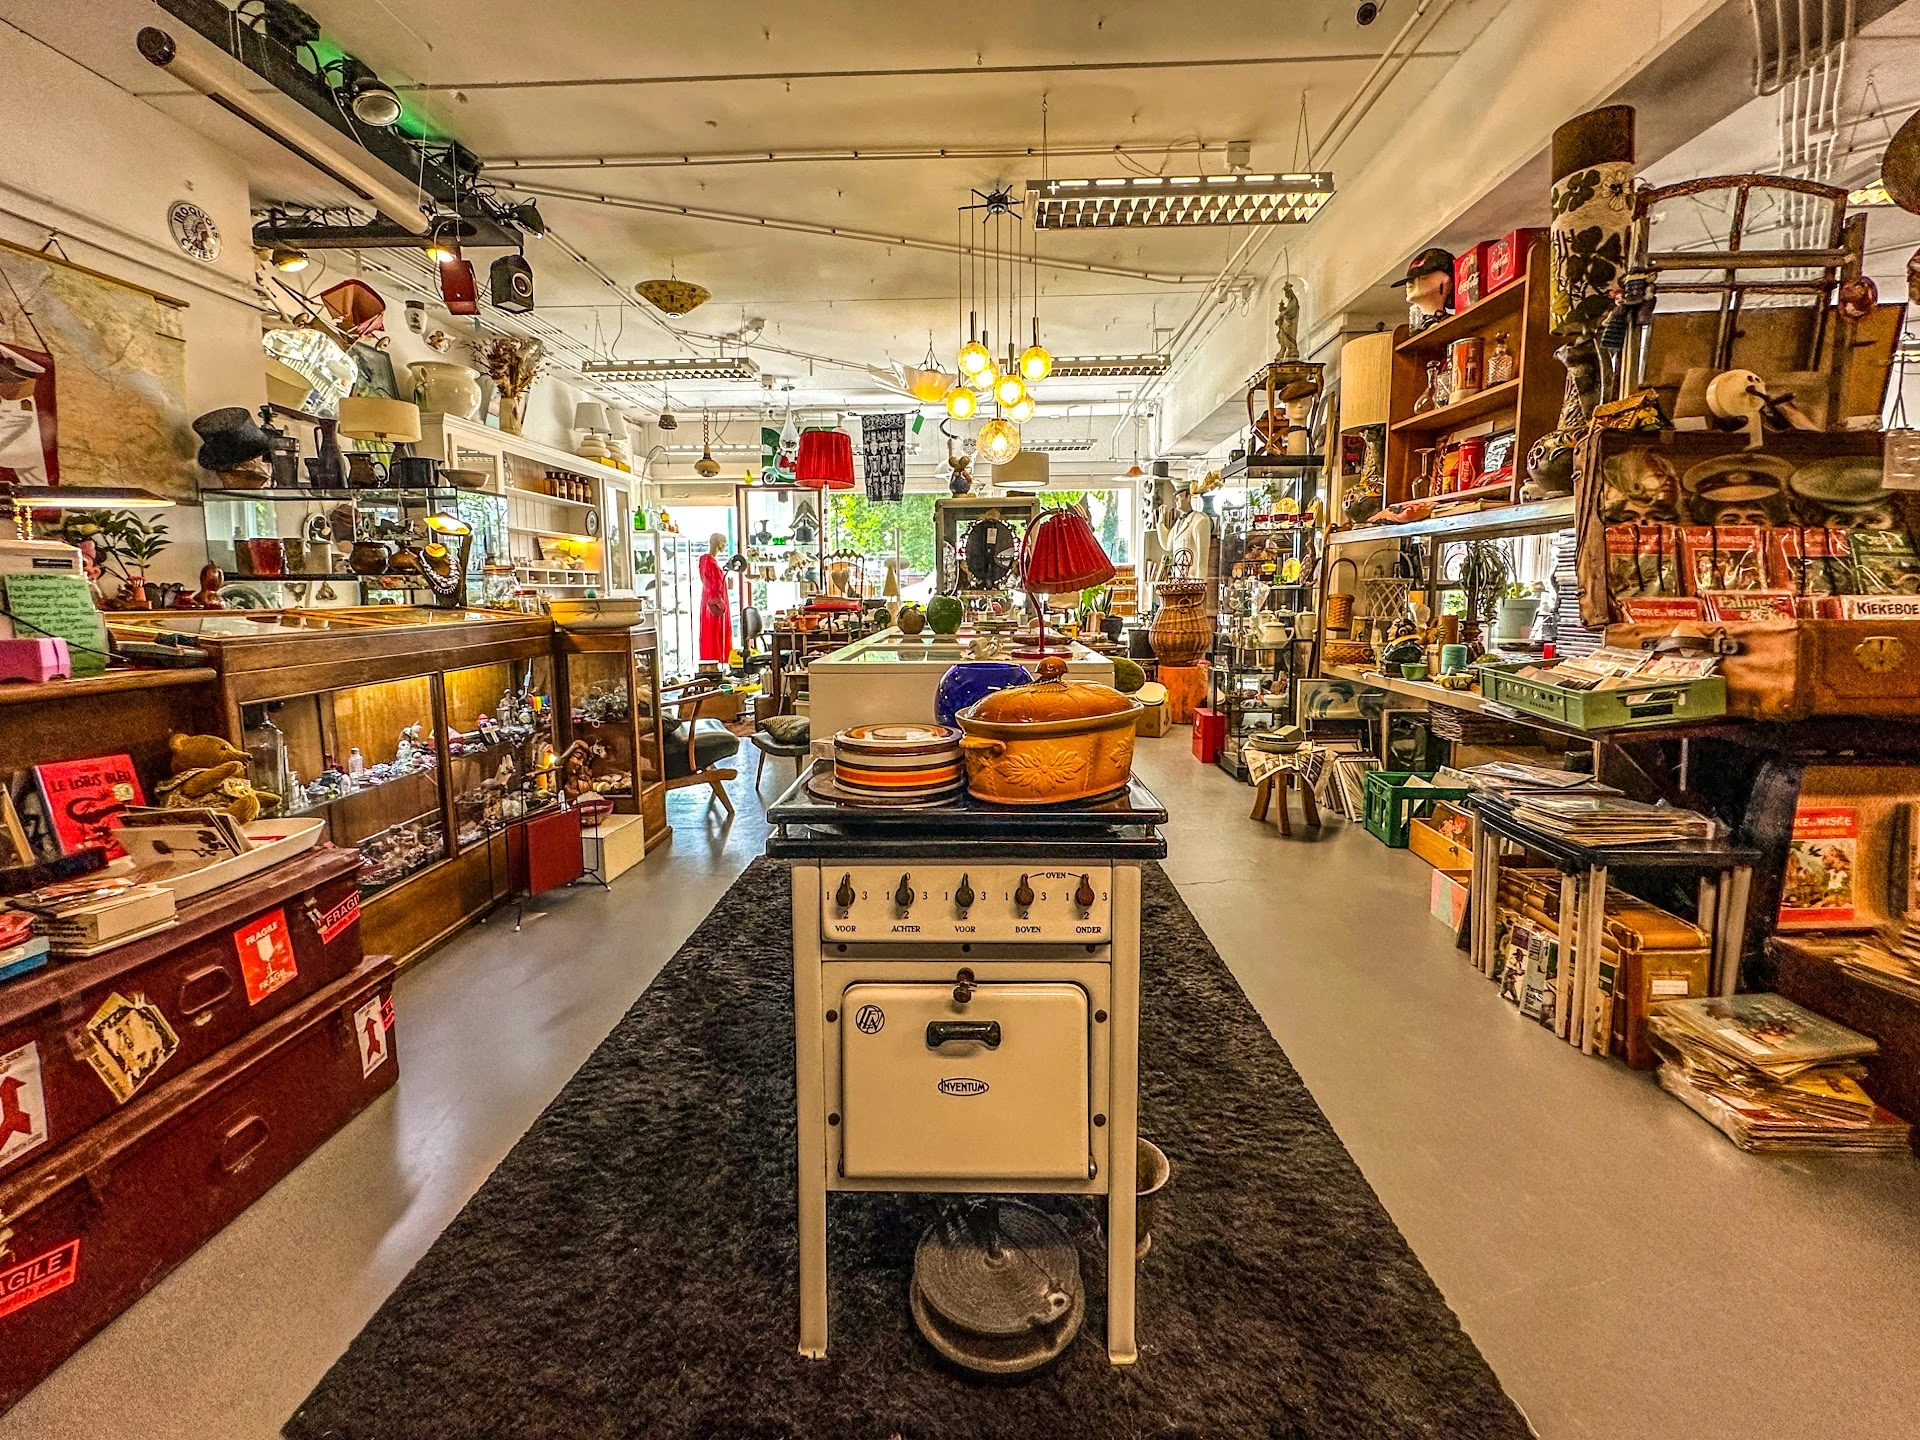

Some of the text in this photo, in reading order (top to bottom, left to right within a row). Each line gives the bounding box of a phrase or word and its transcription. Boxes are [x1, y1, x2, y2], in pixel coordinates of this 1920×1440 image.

[174, 207, 219, 238] IROQUOIS
[1668, 608, 1698, 617] WISKE
[52, 779, 66, 793] LE
[69, 772, 101, 790] LOTUS
[104, 769, 132, 784] BLEU
[1817, 815, 1852, 827] WISKE
[826, 891, 868, 900] 1 3
[886, 891, 928, 900] 1 3
[945, 892, 987, 900] 1 3
[1005, 892, 1047, 900] 1 3
[1066, 892, 1108, 901] 1 3
[843, 911, 849, 919] 2
[904, 911, 910, 919] 2
[962, 911, 968, 919] 2
[1022, 911, 1029, 920] 2
[1084, 911, 1090, 920] 2
[245, 921, 278, 946] FRAGILE
[1075, 926, 1102, 934] ONDER
[5, 1048, 26, 1064] SIDE
[941, 1078, 985, 1093] INVENTUM
